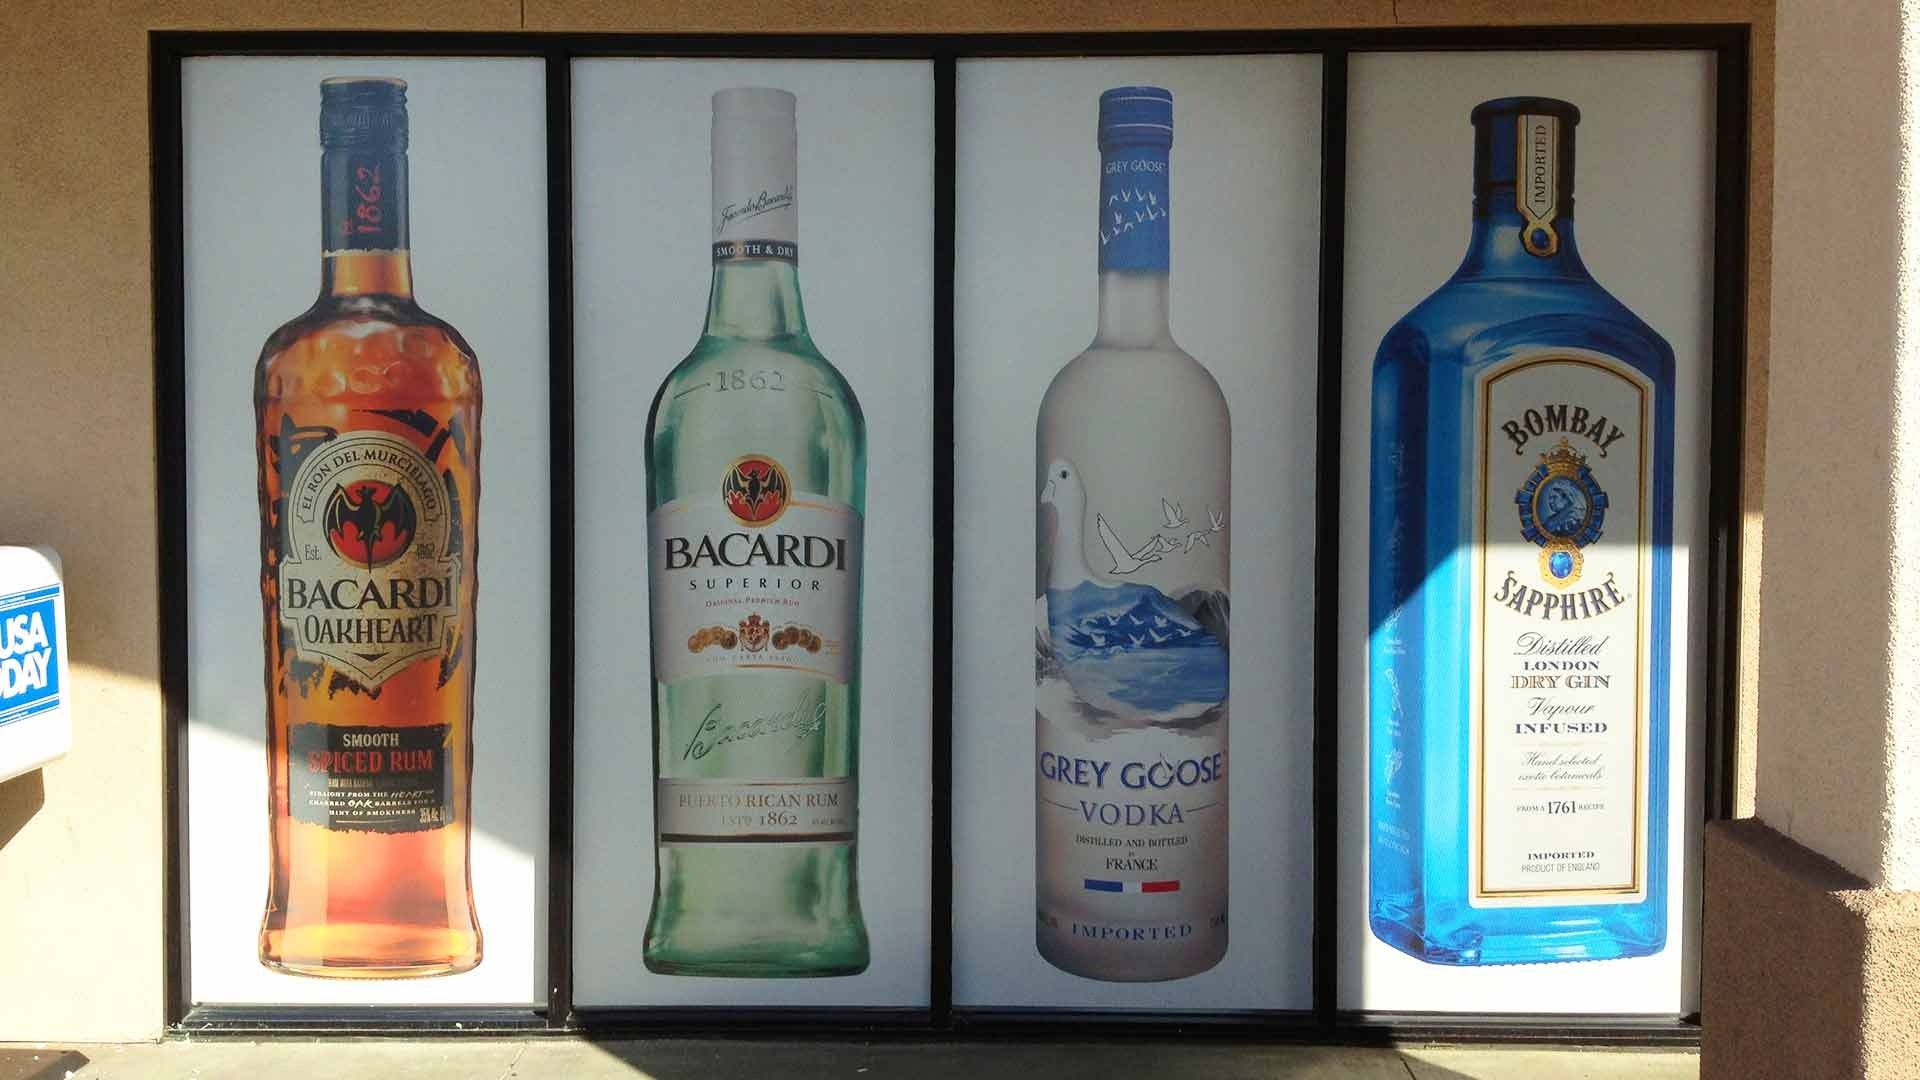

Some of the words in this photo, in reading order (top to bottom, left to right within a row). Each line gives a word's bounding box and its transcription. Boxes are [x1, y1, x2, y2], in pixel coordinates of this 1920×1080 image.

[1106, 161, 1129, 174] GREY
[1535, 125, 1546, 203] IMPORTED
[716, 245, 761, 257] SMOOTH
[765, 245, 773, 255] &
[716, 370, 786, 392] 1862
[1501, 404, 1625, 459] BOMBAY
[333, 450, 361, 468] DEL
[307, 463, 332, 493] RON
[303, 495, 314, 511] EL
[665, 533, 847, 571] BACARDI
[689, 577, 822, 591] SUPERIOR
[288, 578, 451, 611] BACARDI
[1493, 570, 1625, 622] SAPPHIRE
[0, 611, 49, 660] USA
[304, 614, 437, 645] OAKHEART
[1514, 632, 1610, 656] Distilled
[0, 648, 51, 699] DAY
[1524, 661, 1600, 671] LONDON
[1512, 675, 1560, 689] DRY
[1565, 675, 1610, 688] GIN
[1527, 697, 1595, 720] Vapour
[1515, 723, 1608, 734] INFUSED
[343, 733, 399, 748] SMOOTH
[309, 751, 382, 774] SPICED
[391, 751, 432, 771] RUM
[1040, 752, 1111, 788] GREY
[1120, 752, 1222, 789] GOOSE
[347, 799, 374, 808] OAK
[744, 794, 802, 808] RICAN
[806, 793, 840, 807] RUM
[1548, 801, 1576, 814] 1761
[759, 811, 798, 826] 1862
[1080, 800, 1184, 826] VODKA
[1076, 835, 1122, 847] DISTILLED
[1127, 839, 1145, 847] AND
[1106, 858, 1158, 871] FRANCE
[1528, 851, 1595, 860] IMPORTED
[1521, 864, 1555, 872] PRODUCT
[1073, 923, 1191, 941] IMPORTED
